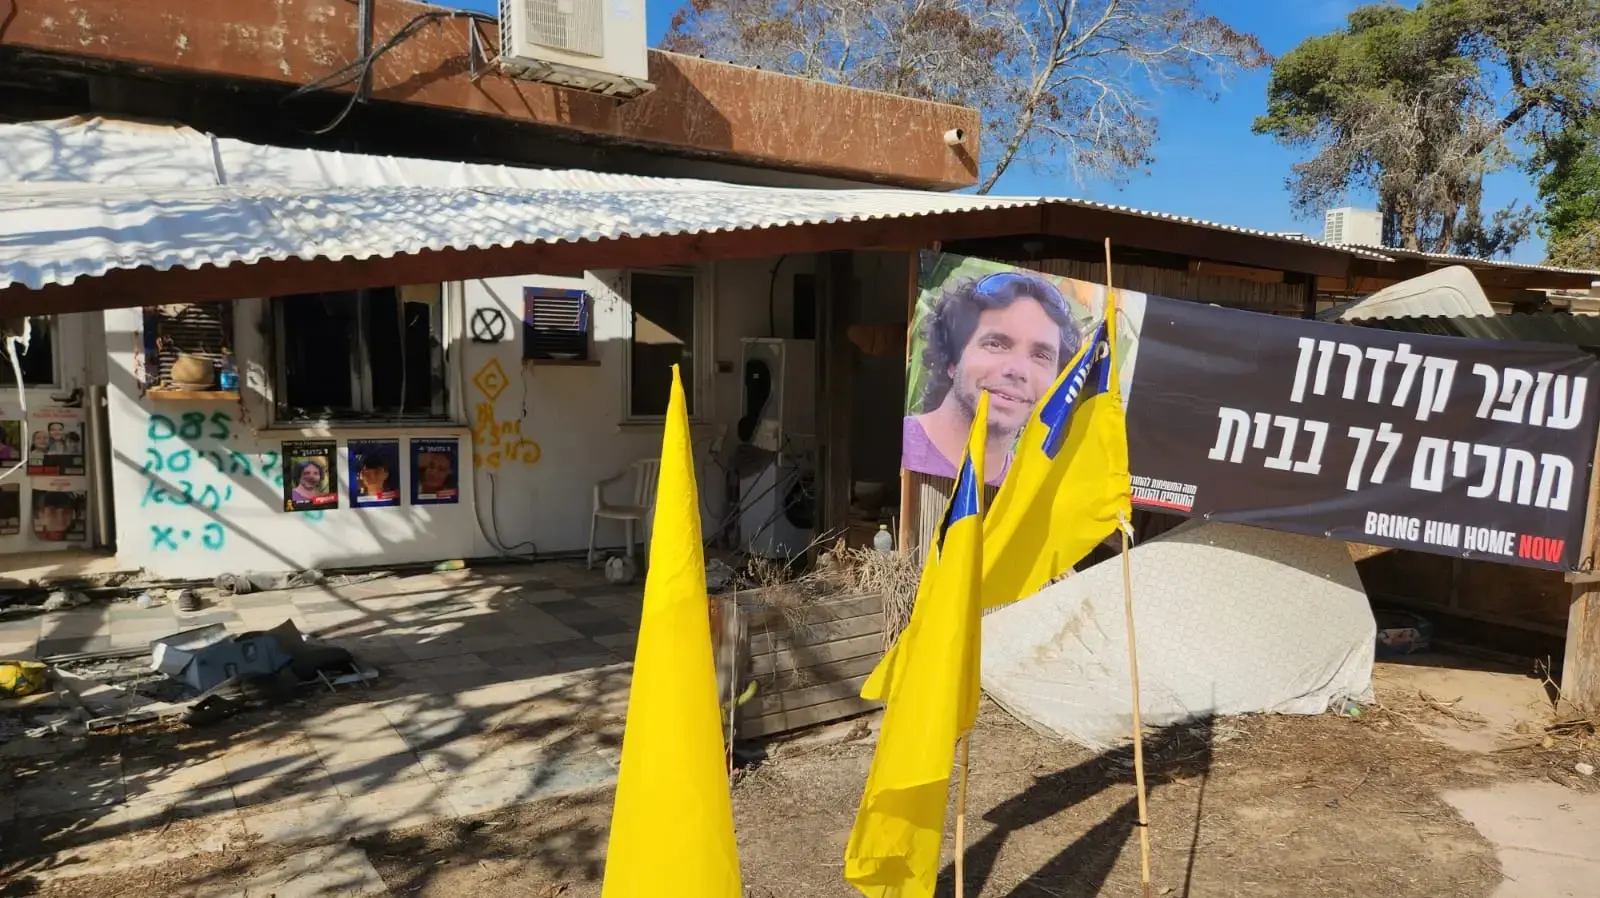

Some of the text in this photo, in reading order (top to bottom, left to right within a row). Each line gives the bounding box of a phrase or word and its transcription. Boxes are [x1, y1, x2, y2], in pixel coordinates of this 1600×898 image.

[1290, 337, 1588, 430] עופר קלדרון
[1208, 406, 1574, 511] מחכים לך בבית
[1364, 511, 1565, 563] BRING HIM HOME NOW
